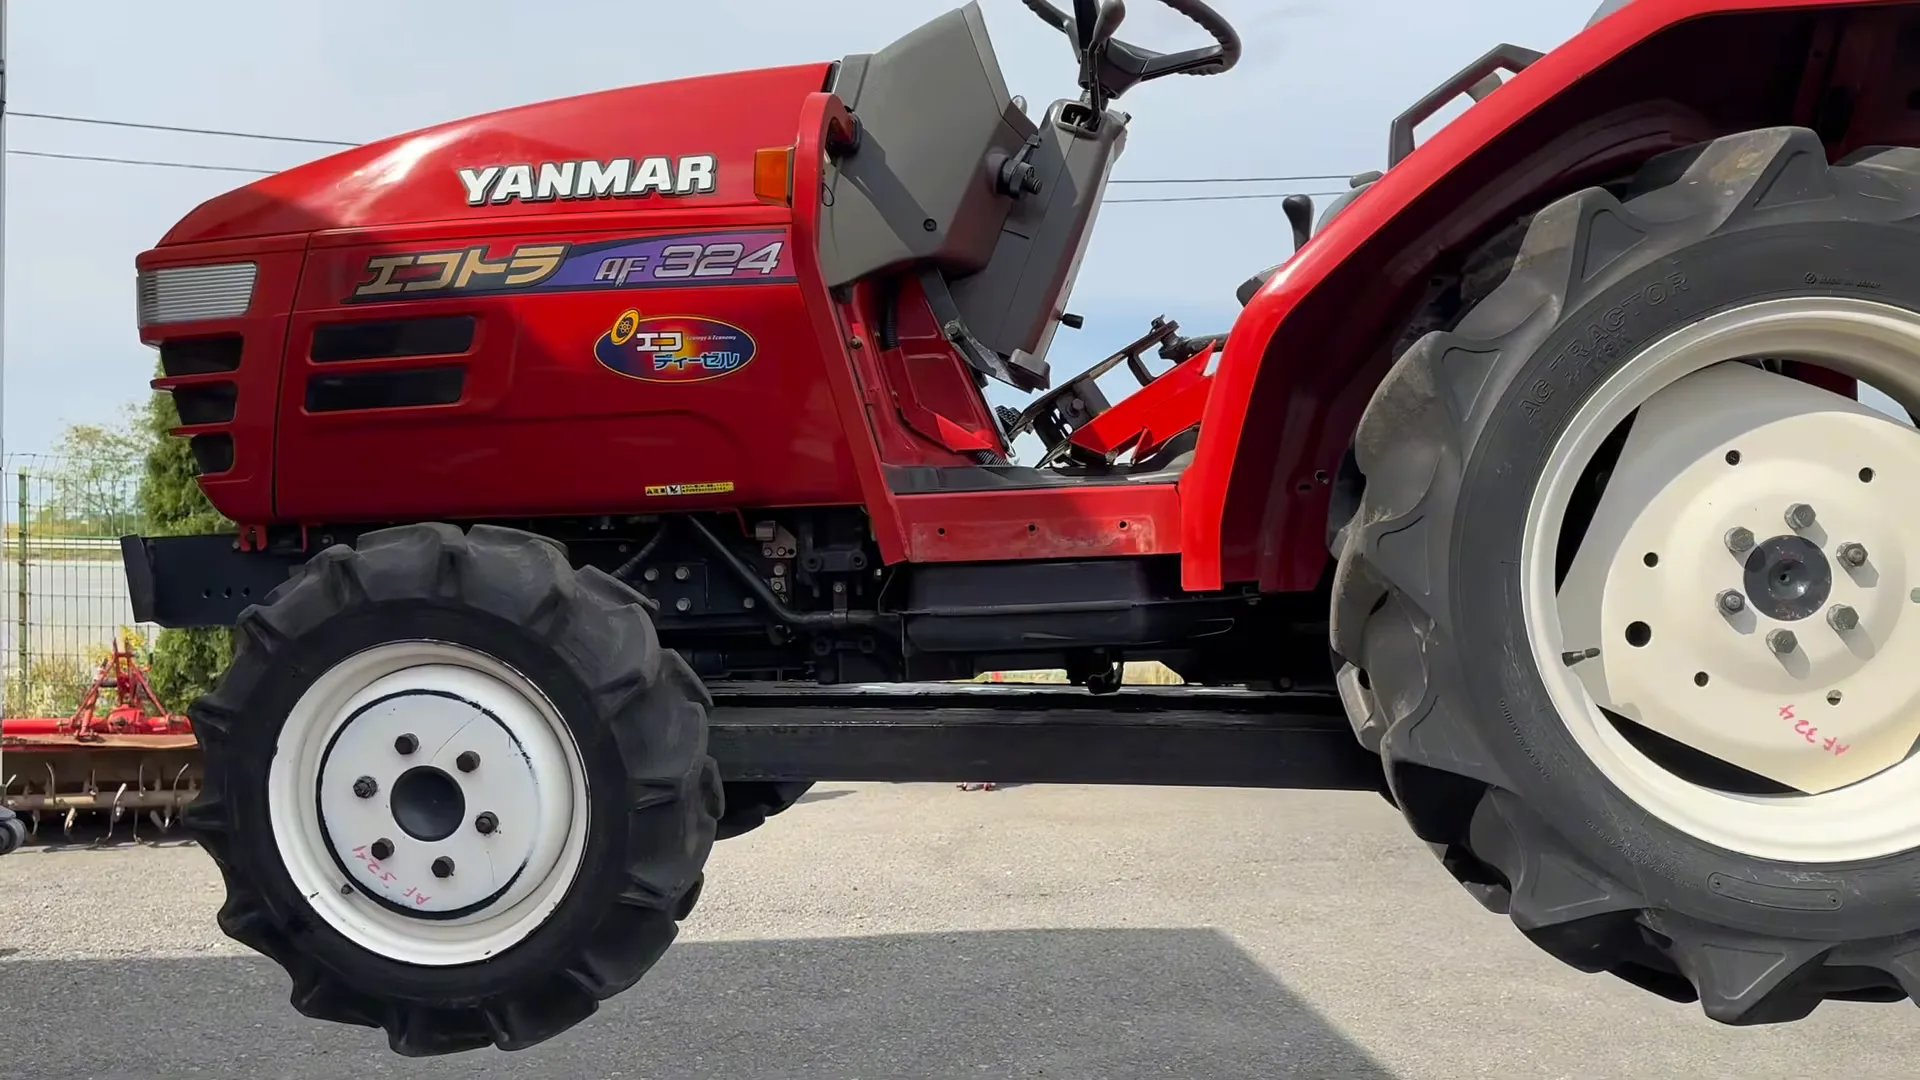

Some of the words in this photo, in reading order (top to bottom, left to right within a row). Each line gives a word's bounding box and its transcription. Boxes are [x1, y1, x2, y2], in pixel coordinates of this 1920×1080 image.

[459, 155, 717, 205] YANMAR
[356, 244, 572, 296] エコトラ
[594, 256, 649, 287] AF
[653, 242, 784, 278] 324
[636, 332, 683, 351] エコ
[1520, 379, 1556, 424] AG
[1550, 271, 1690, 371] TRACTOR
[654, 352, 740, 371] ディーゼル
[1779, 704, 1818, 743] 324
[1823, 737, 1850, 756] AF
